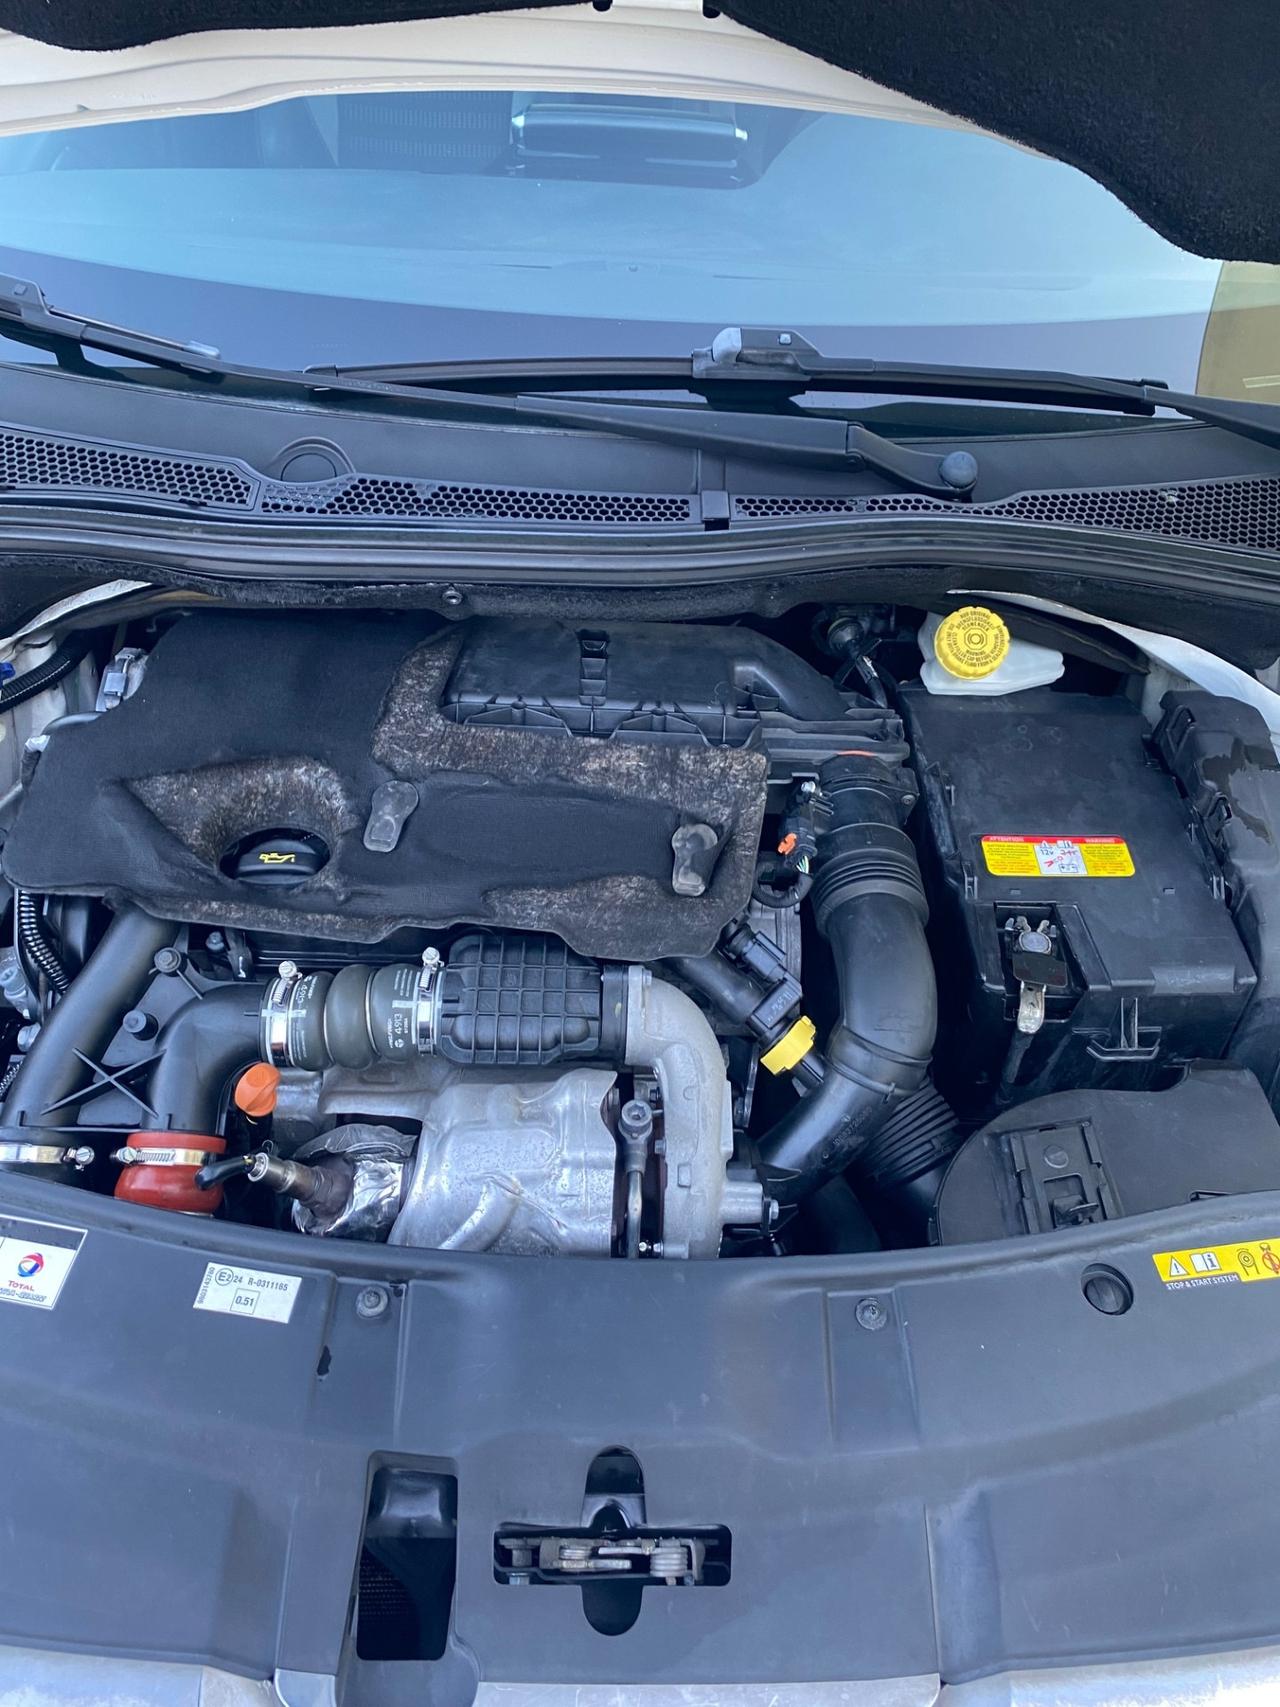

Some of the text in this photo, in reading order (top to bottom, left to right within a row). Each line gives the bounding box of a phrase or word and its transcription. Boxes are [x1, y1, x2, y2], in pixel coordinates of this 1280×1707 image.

[8, 1280, 34, 1292] TOTAL
[1166, 1282, 1184, 1290] STOP
[1192, 1278, 1212, 1288] START
[1212, 1274, 1239, 1284] SYSTEM
[235, 1296, 254, 1306] 0.51
